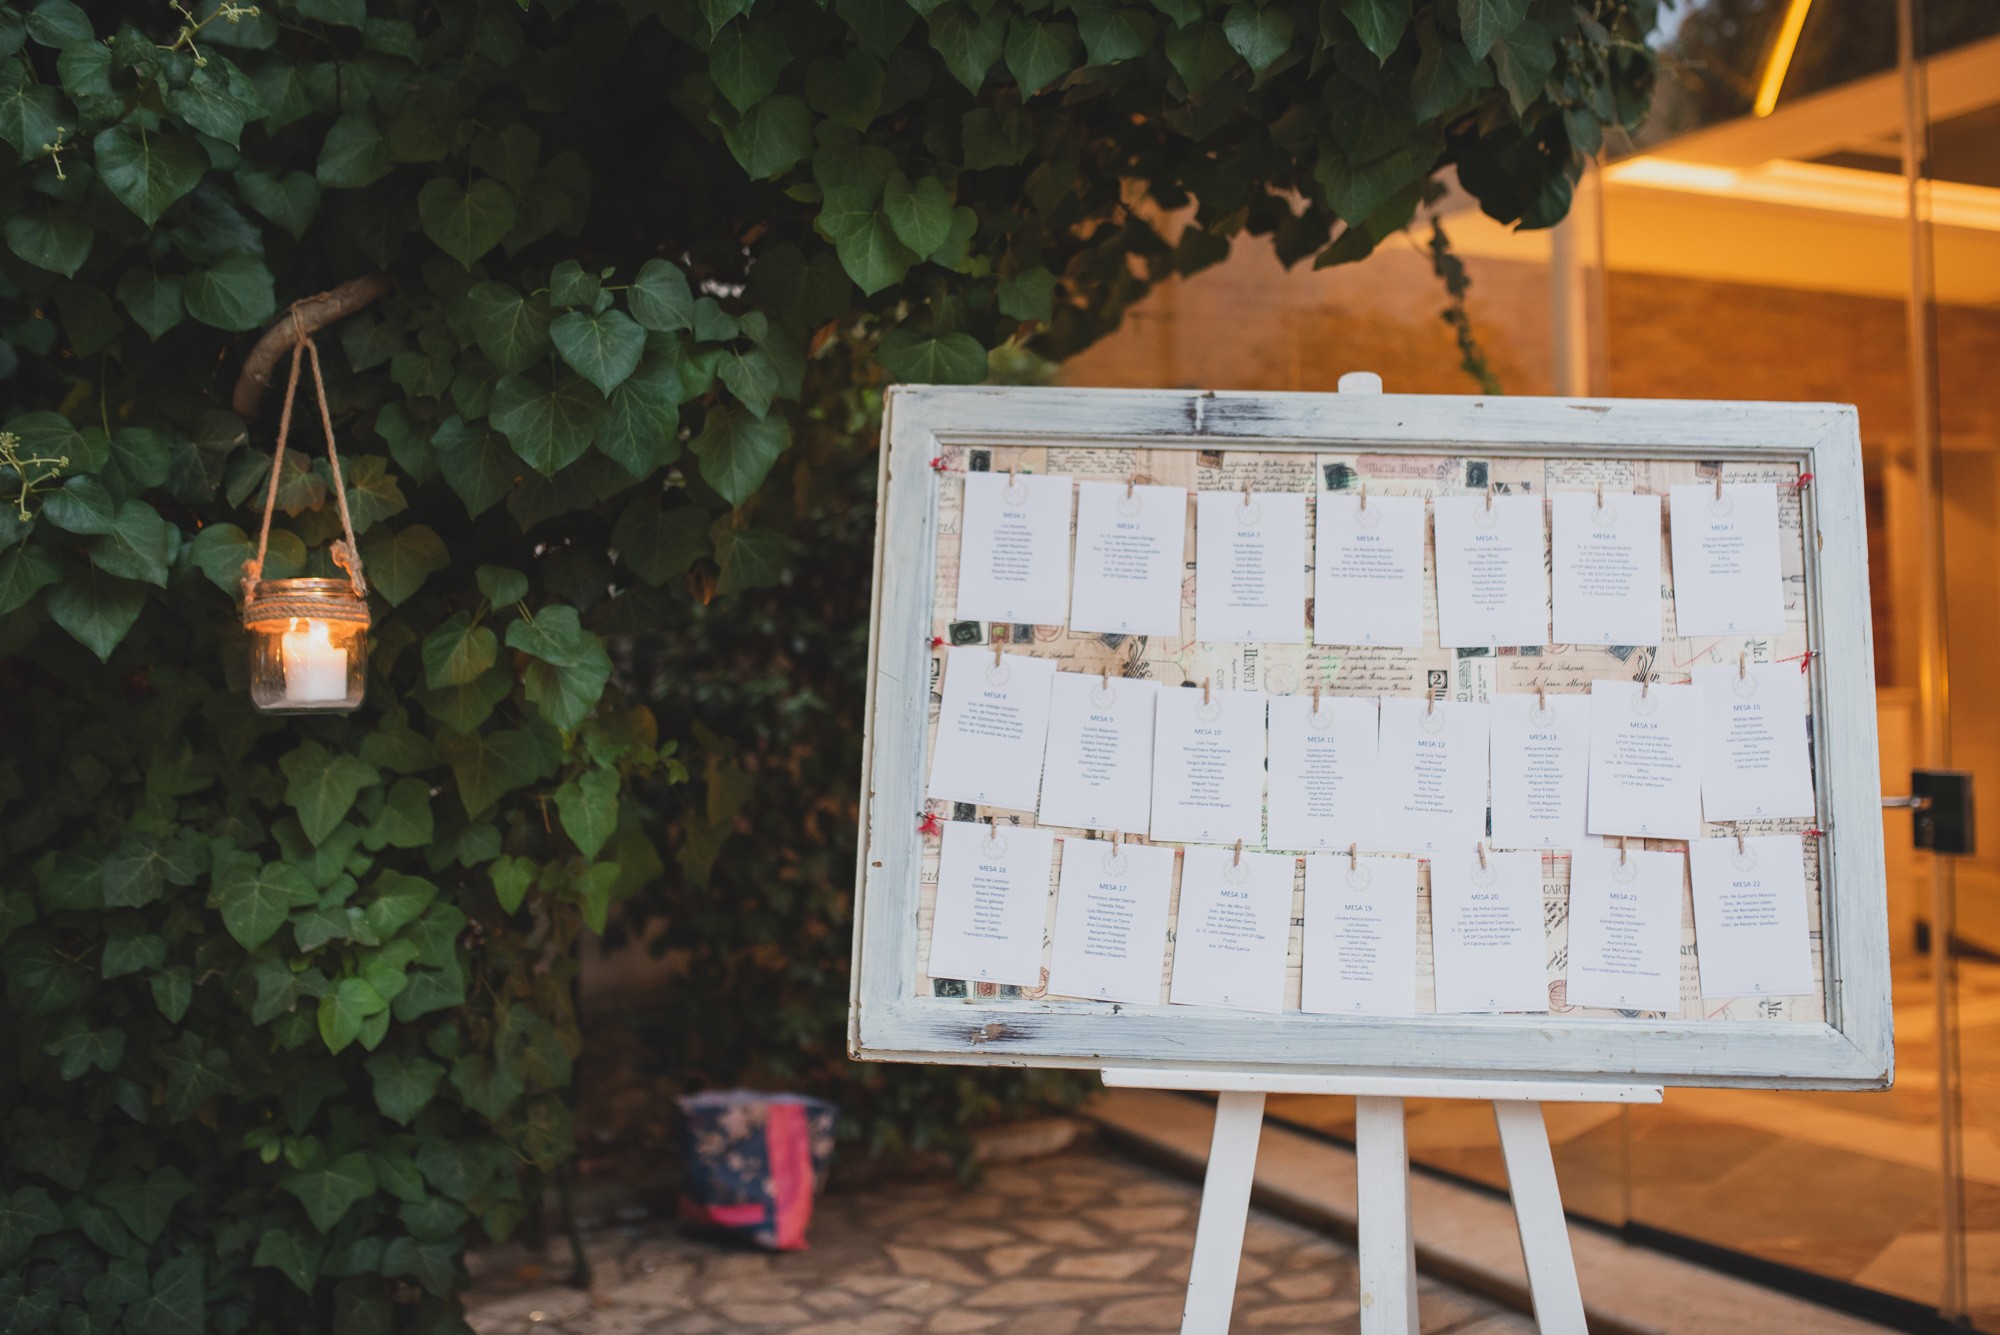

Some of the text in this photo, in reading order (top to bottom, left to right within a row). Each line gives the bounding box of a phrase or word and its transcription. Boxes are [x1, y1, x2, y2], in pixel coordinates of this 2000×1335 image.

[1244, 649, 1257, 685] HENRY
[1433, 673, 1443, 686] 2
[1089, 714, 1108, 722] MESA
[1417, 740, 1436, 748] MESA
[978, 865, 998, 873] MESA
[1098, 883, 1118, 892] MESA
[1220, 890, 1240, 899] MESA
[1609, 893, 1629, 901] MESA
